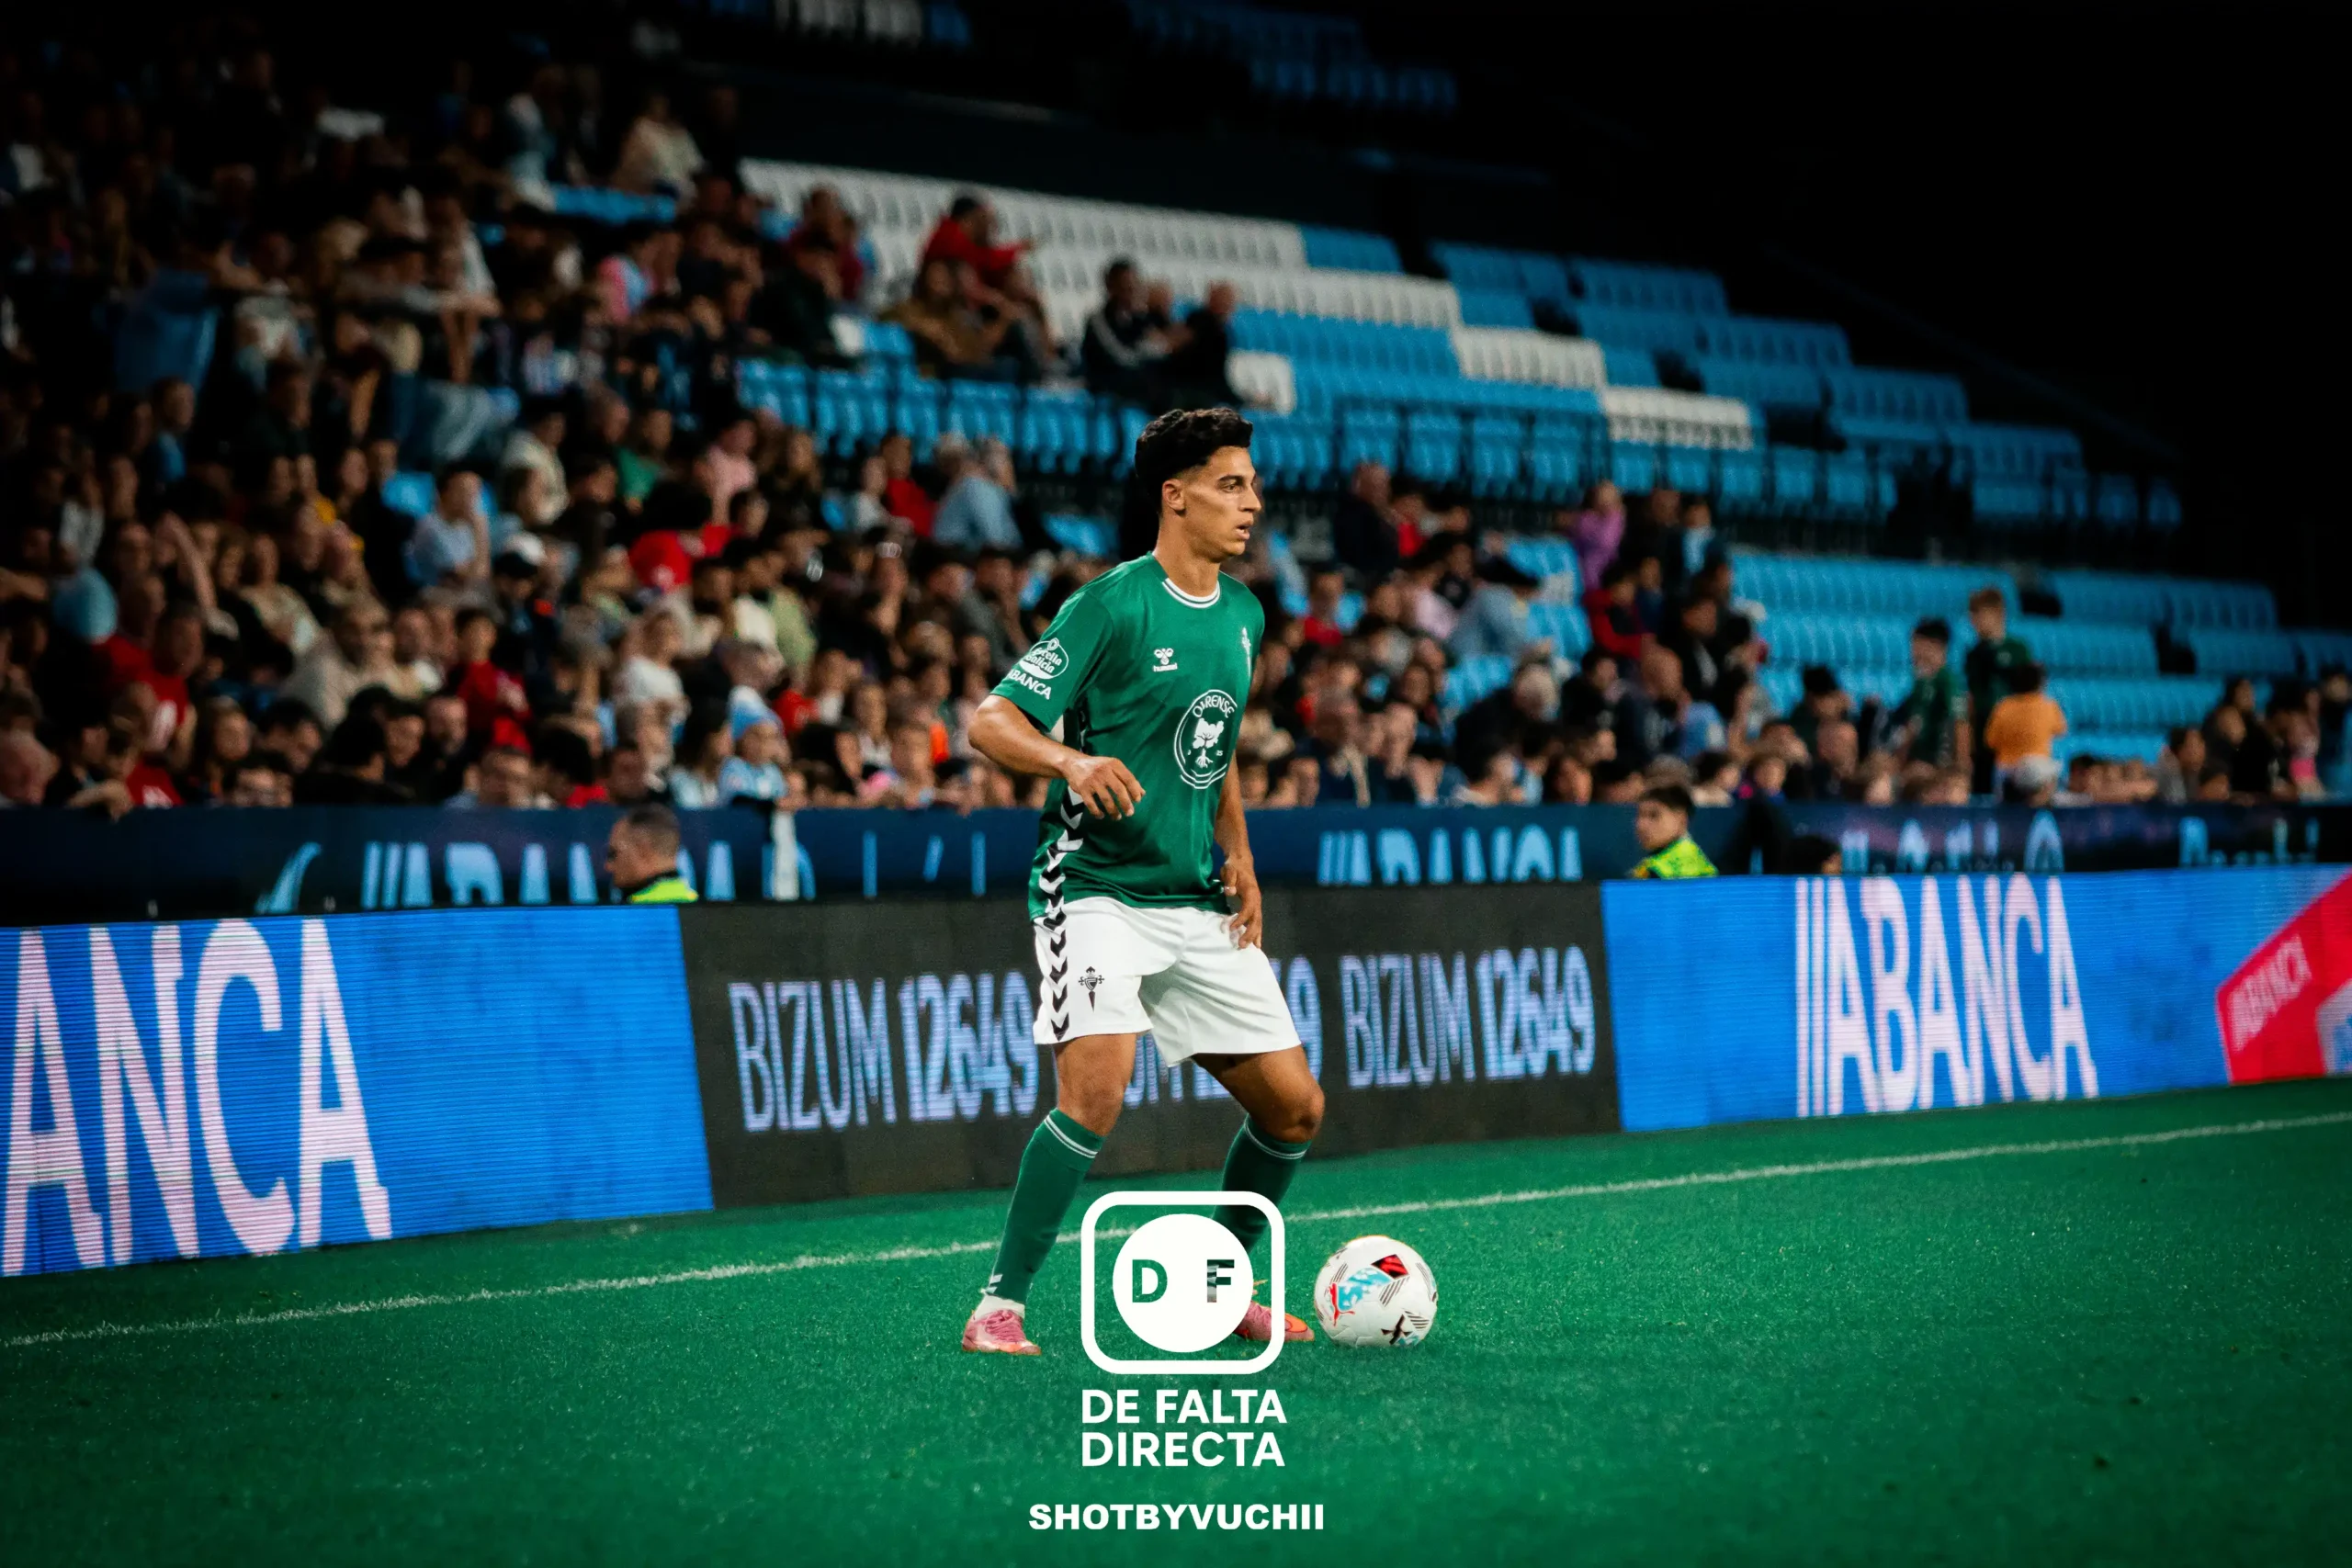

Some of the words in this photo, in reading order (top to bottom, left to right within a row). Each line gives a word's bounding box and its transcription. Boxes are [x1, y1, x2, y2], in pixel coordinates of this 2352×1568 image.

[728, 979, 898, 1133] BIZUM
[898, 971, 1039, 1122] 12649
[1341, 952, 1476, 1088] BIZUM
[1475, 945, 1596, 1080] 12649
[1826, 873, 2098, 1115] ABANCA
